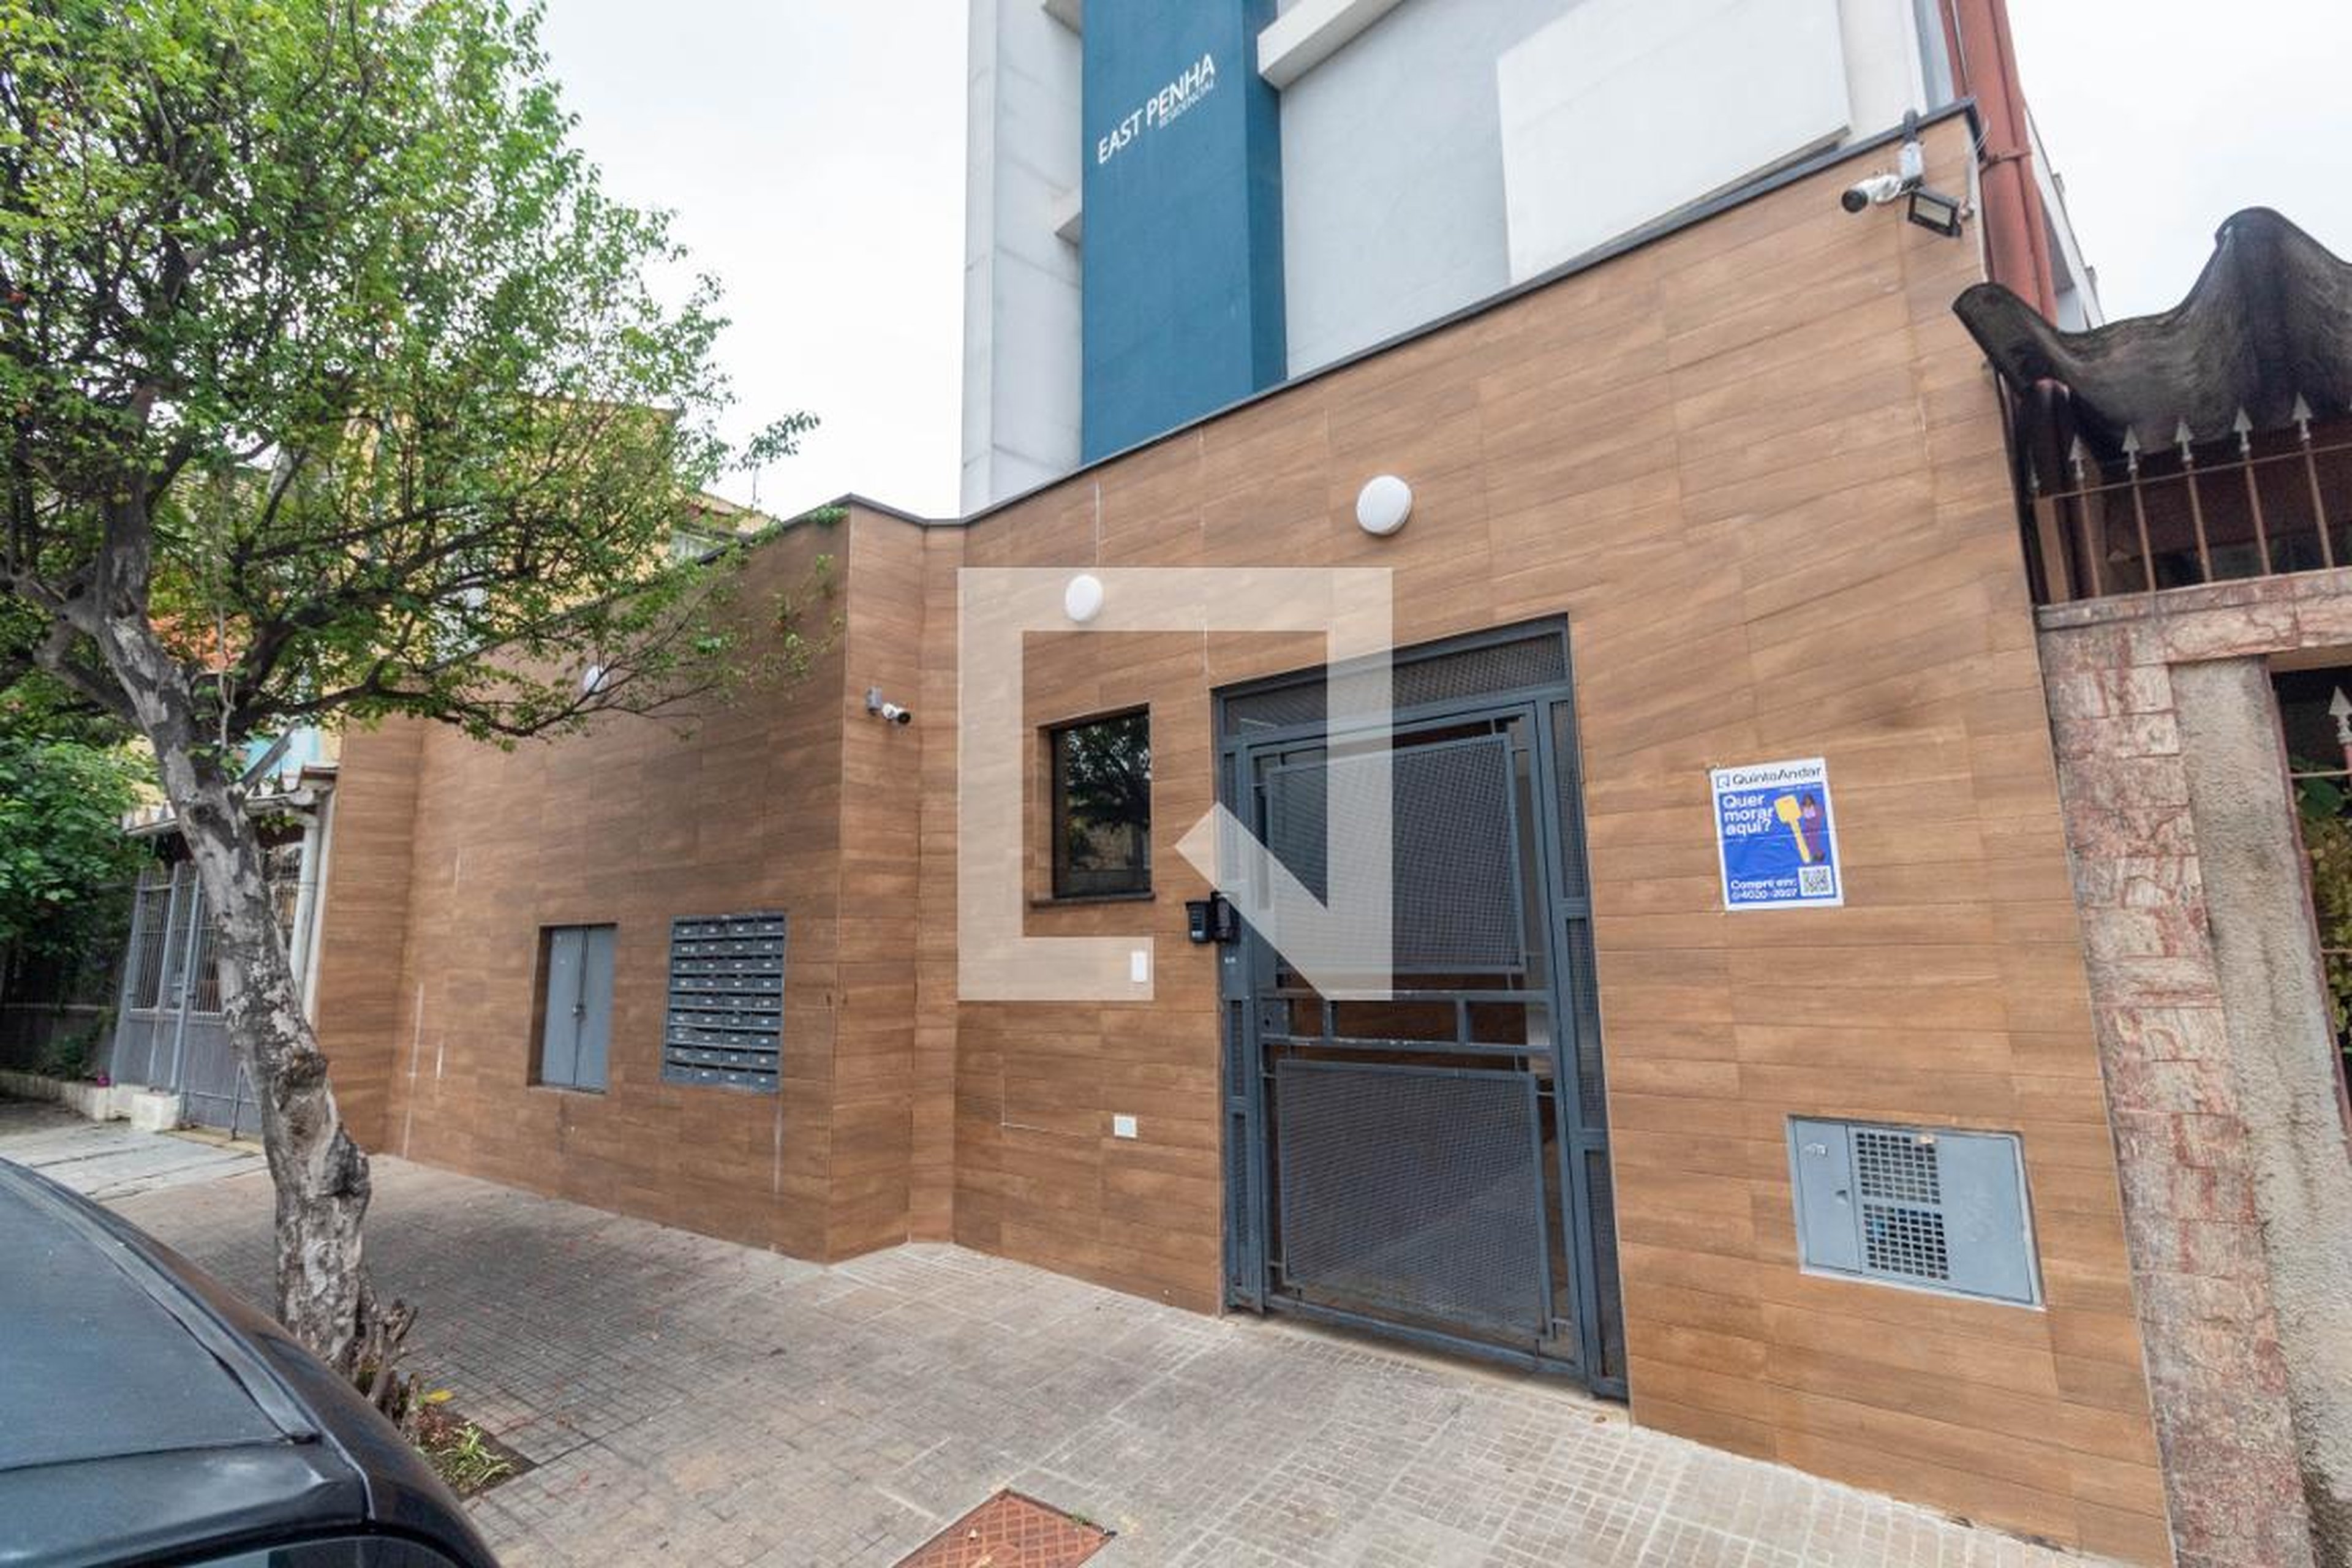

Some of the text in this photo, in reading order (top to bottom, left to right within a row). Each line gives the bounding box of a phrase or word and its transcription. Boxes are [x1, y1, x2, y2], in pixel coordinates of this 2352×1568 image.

[1098, 53, 1215, 164] EAST PENHA
[1733, 767, 1821, 785] QuintoAndar
[1723, 794, 1765, 809] Quer
[1725, 807, 1774, 822] morar
[1725, 819, 1771, 837] aqui?
